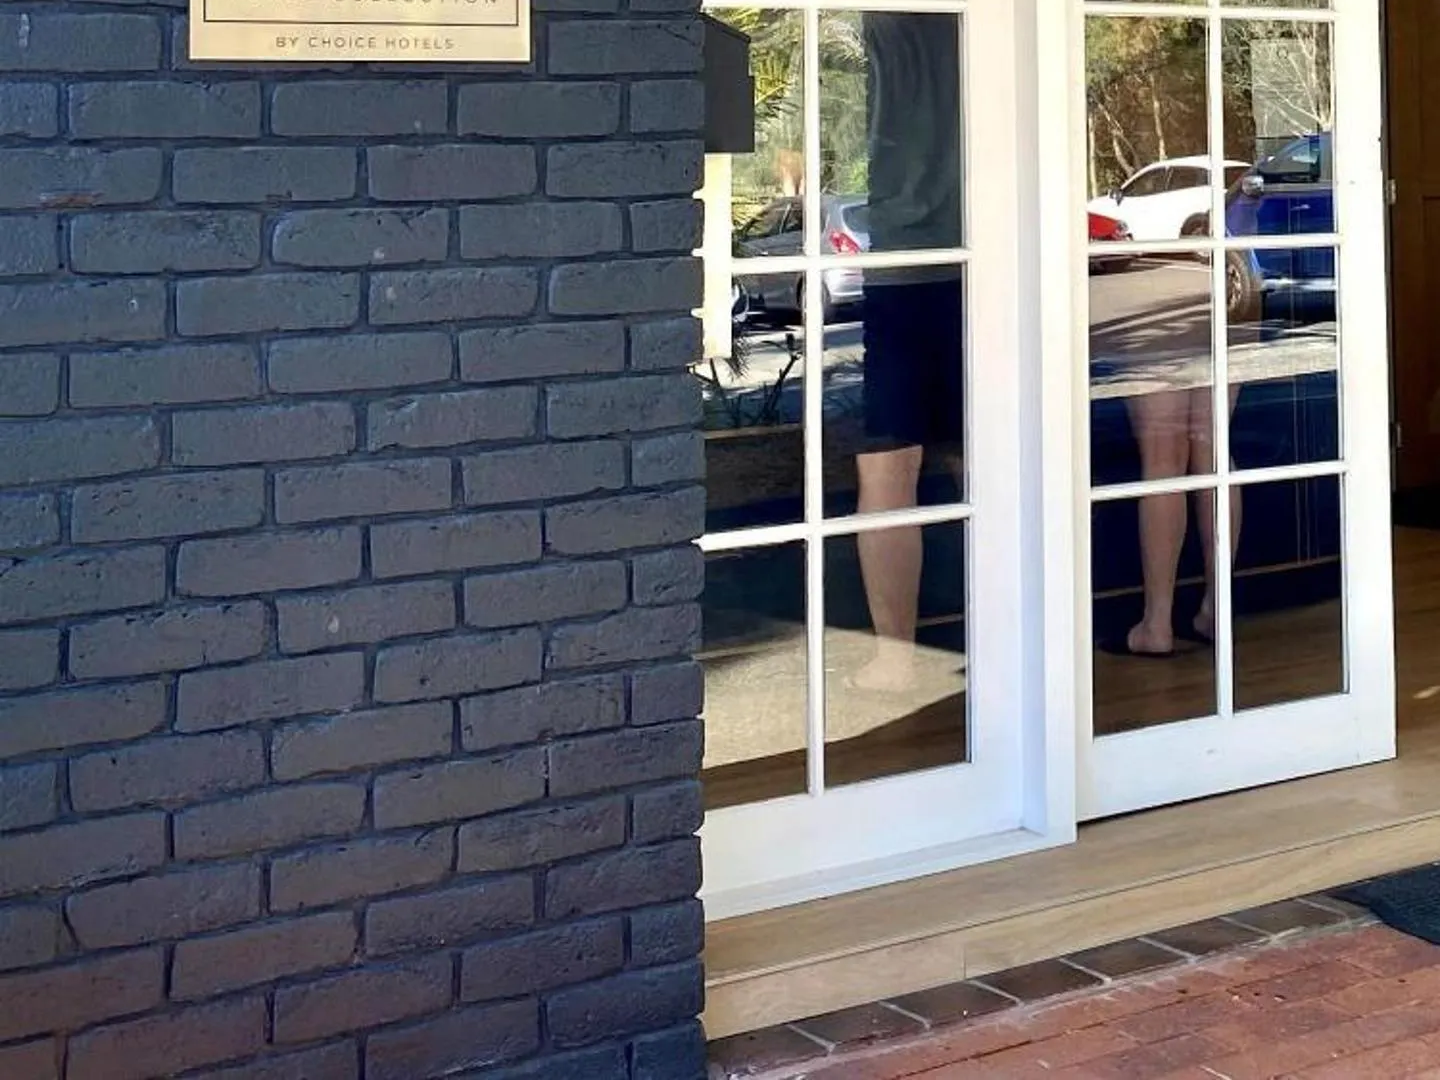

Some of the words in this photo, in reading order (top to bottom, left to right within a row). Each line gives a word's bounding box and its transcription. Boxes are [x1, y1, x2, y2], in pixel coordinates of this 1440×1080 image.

[275, 36, 299, 47] BY
[308, 36, 378, 49] CHOICE
[385, 37, 455, 50] HOTELS
